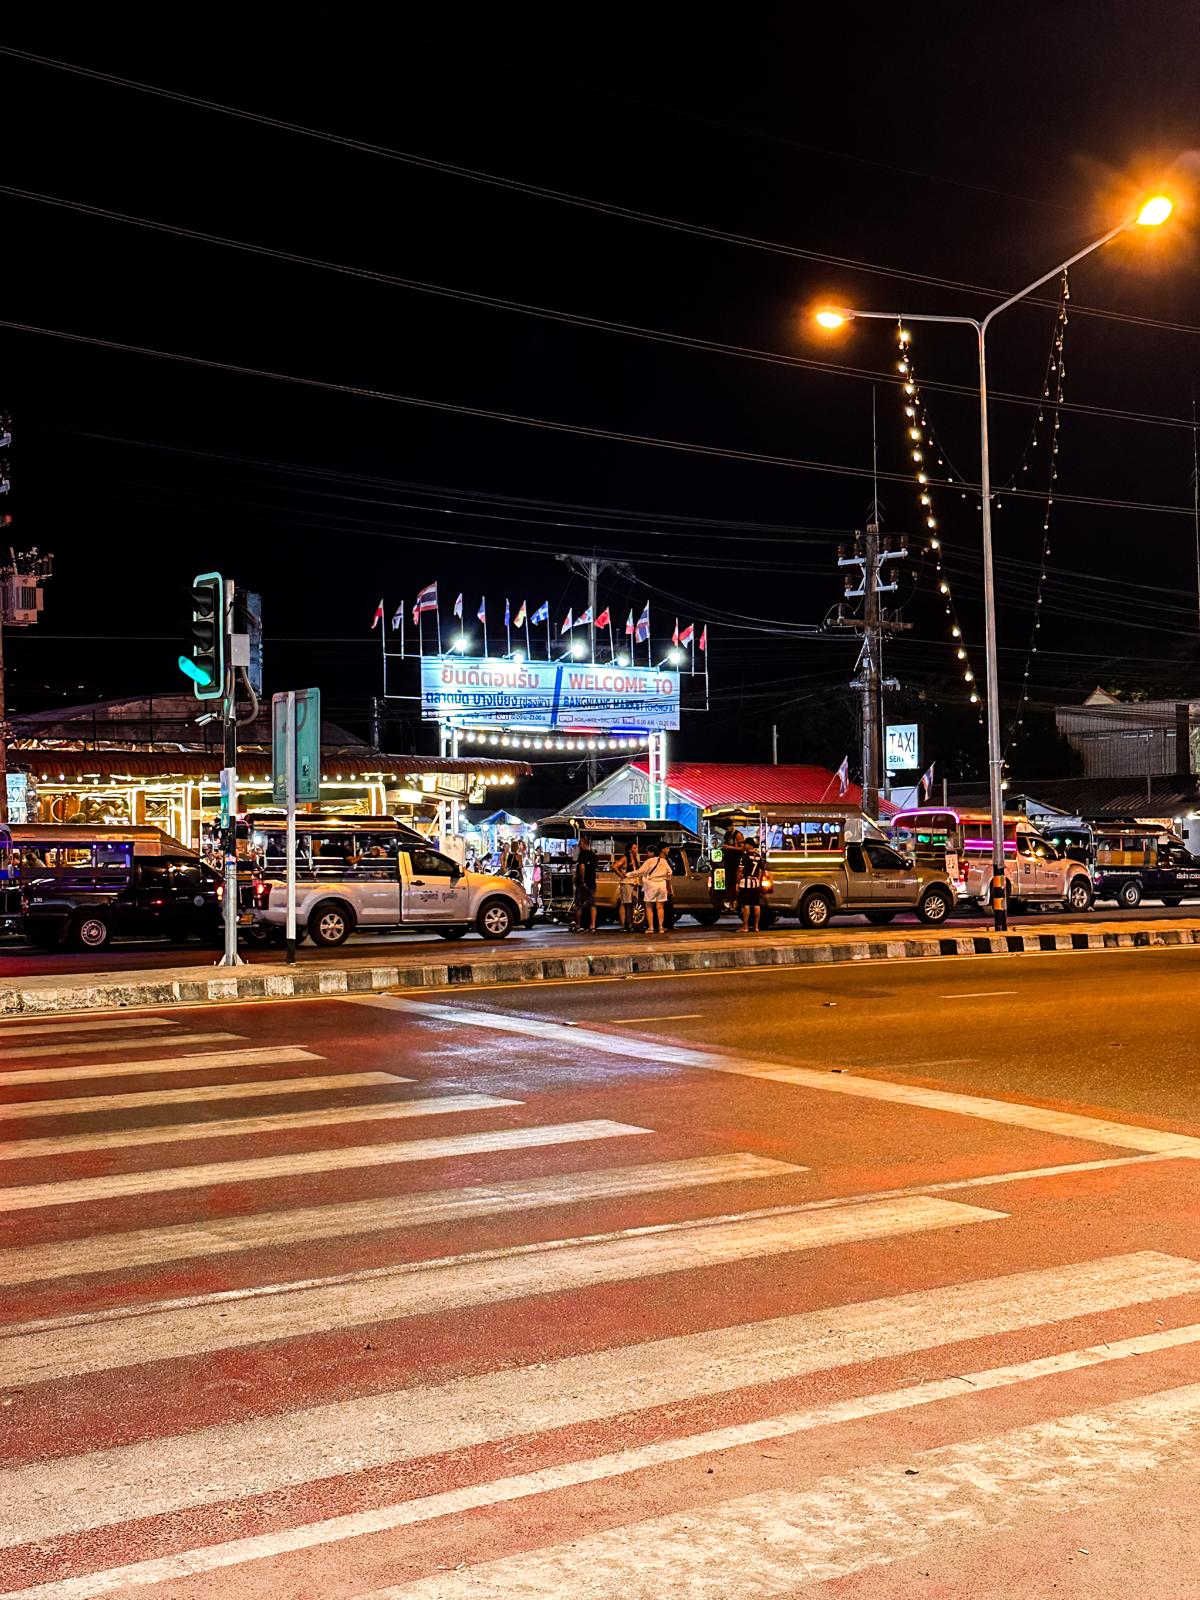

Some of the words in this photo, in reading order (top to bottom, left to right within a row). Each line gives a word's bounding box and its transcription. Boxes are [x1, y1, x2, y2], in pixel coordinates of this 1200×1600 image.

[568, 673, 648, 693] WELCOME
[653, 678, 673, 694] TO
[889, 731, 915, 753] TAXI
[628, 793, 648, 804] POIN
[751, 861, 758, 876] 7
